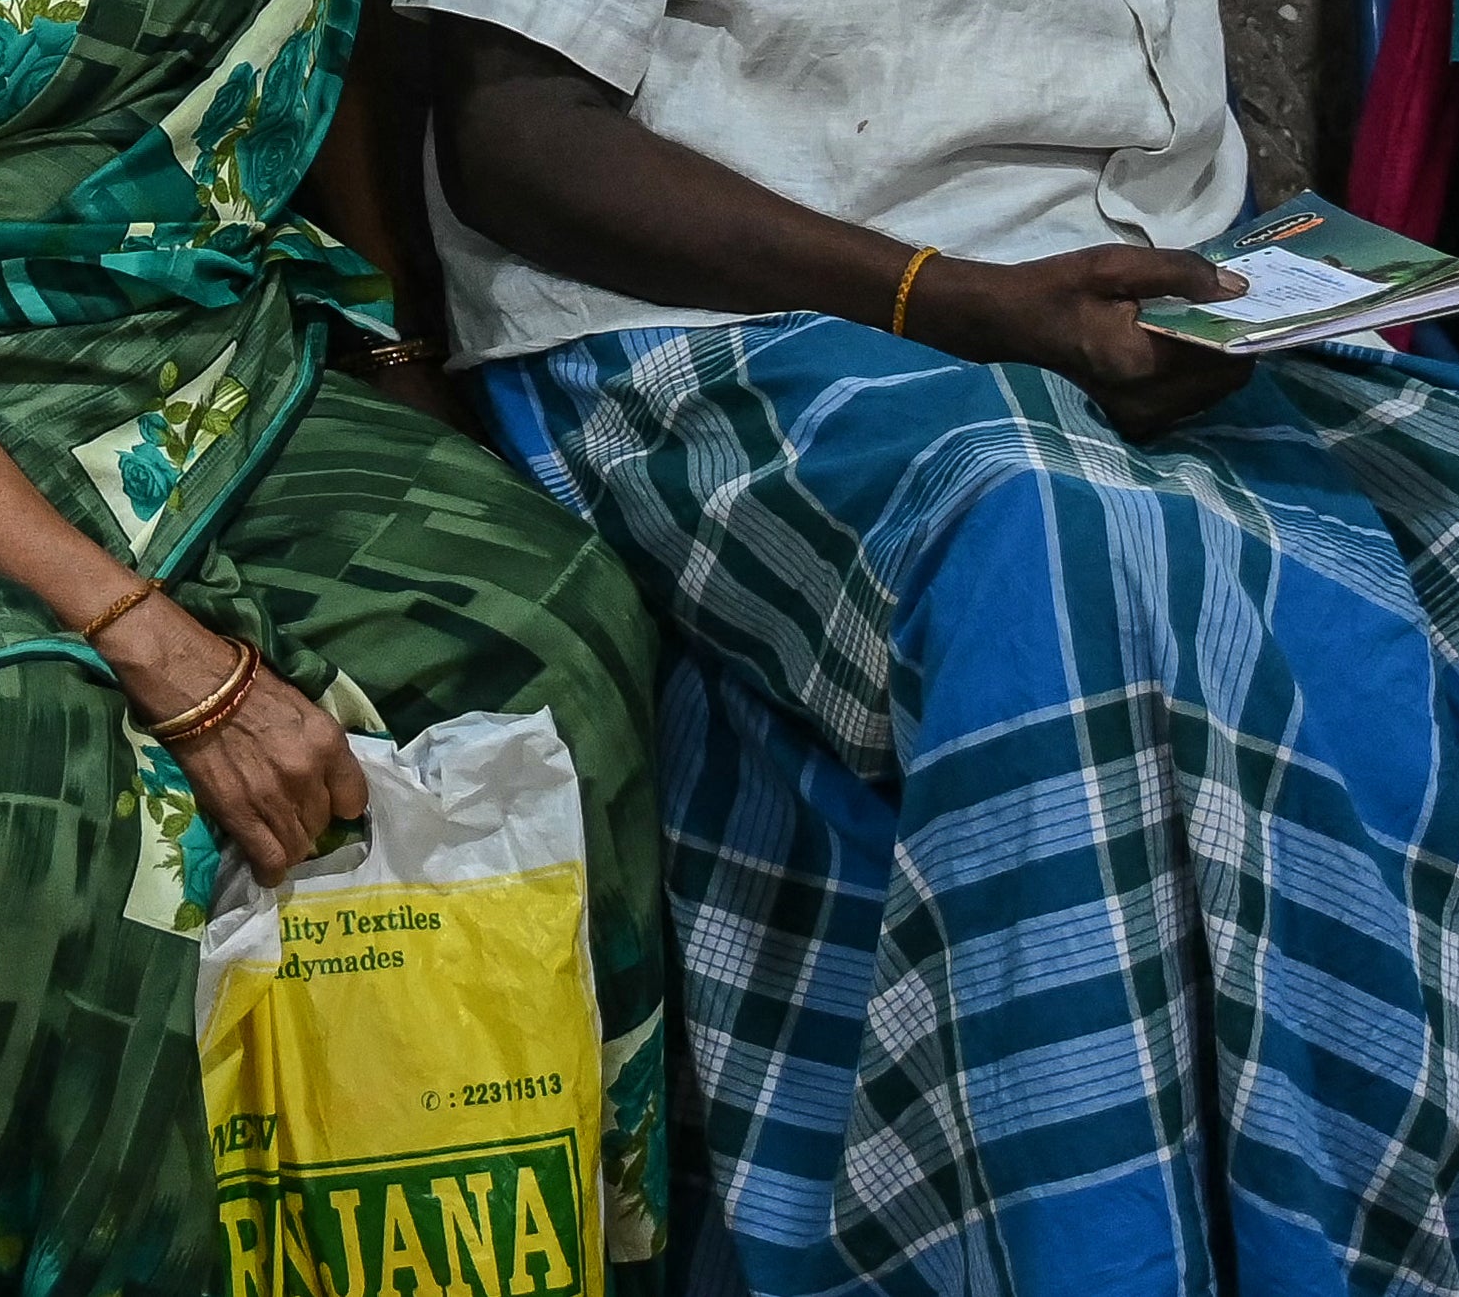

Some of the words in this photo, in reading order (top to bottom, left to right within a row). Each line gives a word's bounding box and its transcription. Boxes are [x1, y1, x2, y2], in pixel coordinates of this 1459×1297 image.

[281, 917, 329, 944] lity
[337, 905, 441, 936] Textiles
[463, 1073, 563, 1108] 22311513
